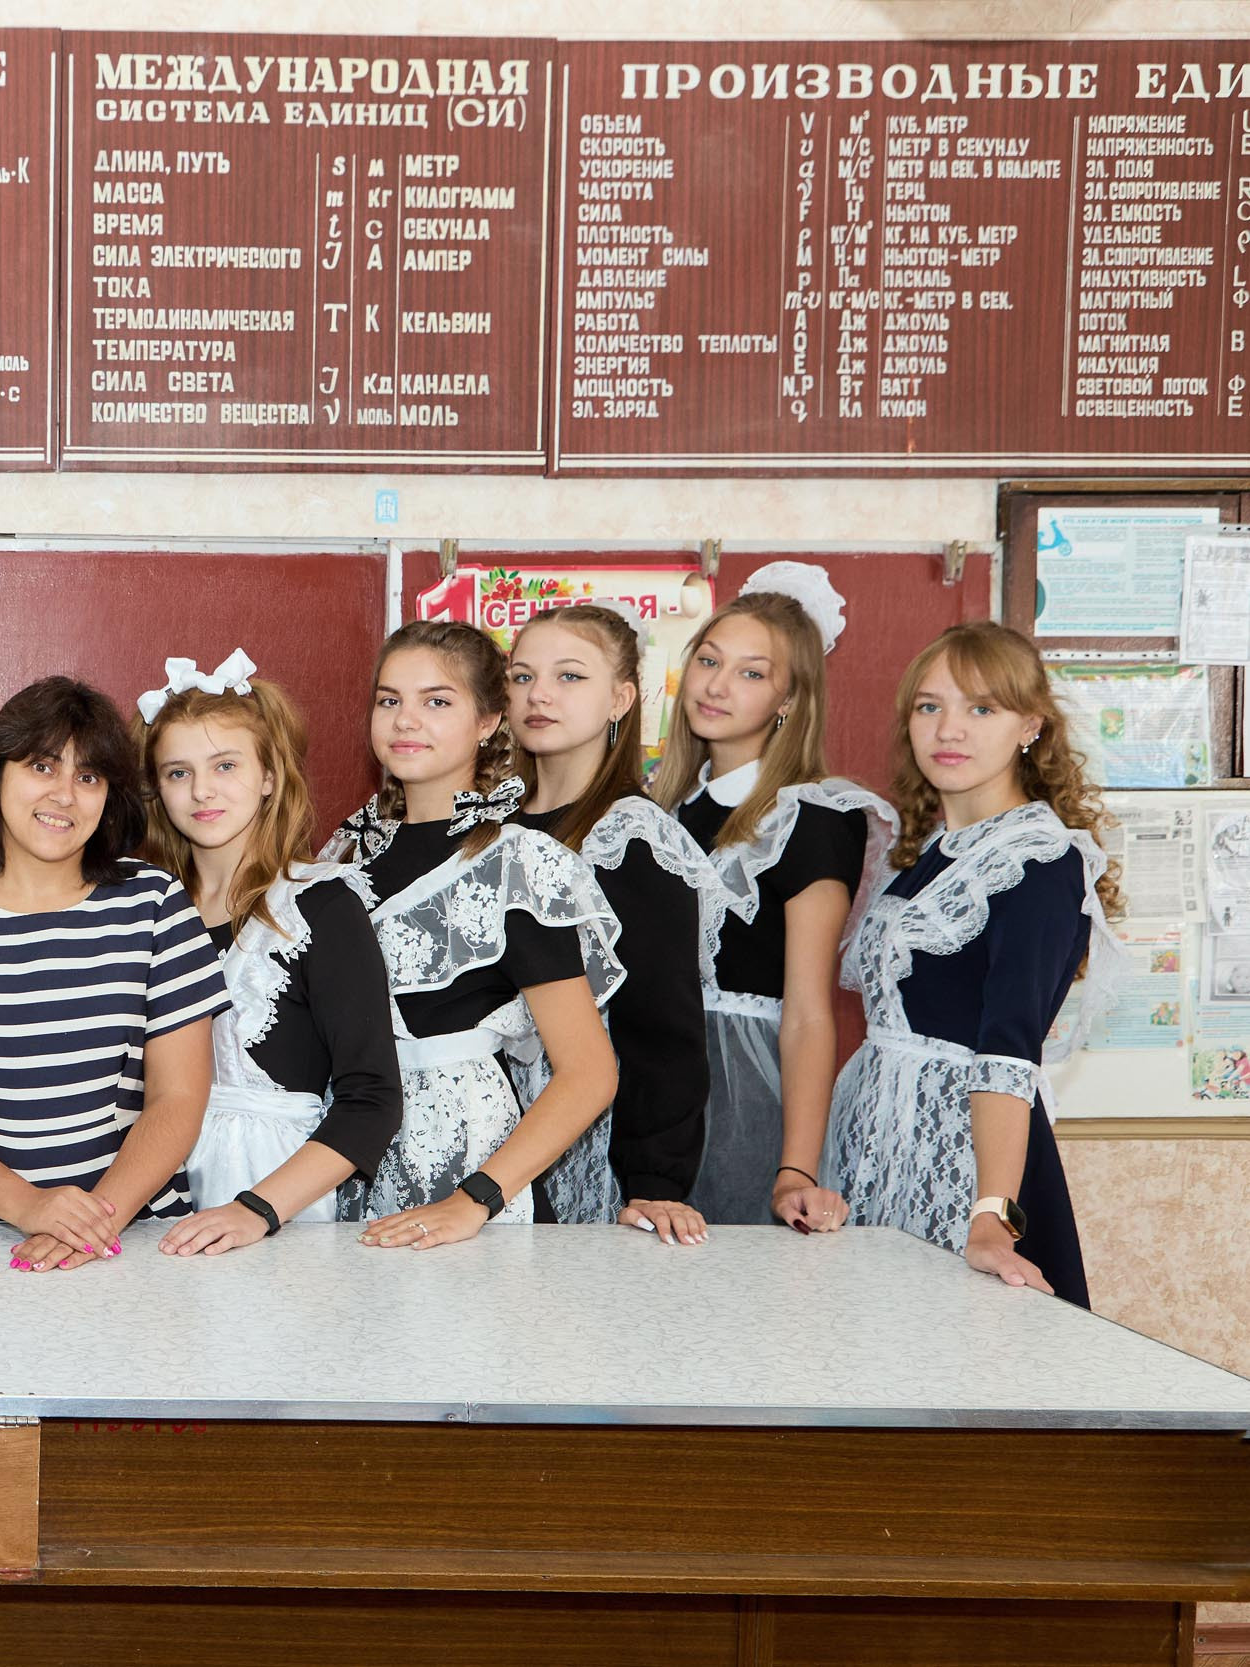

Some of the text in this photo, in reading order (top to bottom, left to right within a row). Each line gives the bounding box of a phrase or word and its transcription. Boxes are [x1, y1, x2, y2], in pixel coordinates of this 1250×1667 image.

[95, 53, 530, 99] МЕЖДУНАРОДНАЯ
[621, 63, 1098, 105] ПРОИЗВОДНЫЕ
[95, 95, 527, 132] СИСТЕМА ЕДИНИЦ (СИ)
[800, 111, 815, 135] V
[1088, 114, 1187, 134] НАПРЯЖЕНИЕ
[580, 114, 642, 135] ОБЪЕМ
[889, 115, 969, 135] КУБ. МЕТР
[579, 137, 666, 157] СКОРОСТЬ
[888, 137, 1030, 157] МЕТР В СЕКУНДУ
[1086, 137, 1214, 157] НАПРЯЖЕННОСТЬ
[93, 149, 231, 175] ДЛИНА, ПУТЬ
[405, 154, 460, 178] МЕТР
[579, 158, 674, 179] УСКОРЕНИЕ
[886, 159, 1061, 179] МЕТР НА СЕК. В КВАДРАТЕ
[1085, 159, 1154, 179] ЭЛ. ПОЛЯ
[93, 181, 165, 205] МАССА
[404, 185, 516, 210] КИЛОГРАММ
[578, 181, 654, 201] ЧАСТОТА
[886, 181, 926, 202] ГЕРЦ
[578, 203, 623, 223] СИЛА
[885, 203, 951, 223] НЬЮТОН
[1083, 203, 1182, 223] ЭЛ. ЕМКОСТЬ
[93, 212, 164, 236] ВРЕМЯ
[403, 217, 491, 241] СЕКУНДА
[577, 224, 674, 245] ПЛОТНОСТЬ
[885, 225, 1018, 245] КГ. НА КУБ. МЕТР
[1082, 225, 1162, 245] УДЕЛЬНОЕ
[92, 244, 302, 269] СИЛА ЭЛЕКТРИЧЕСКОГО
[403, 249, 472, 272] АМПЕР
[576, 246, 709, 267] МОМЕНТ СИЛЫ
[92, 276, 151, 299] ТОКА
[576, 268, 667, 288] ДАВЛЕНИЕ
[884, 269, 952, 288] ПАСКАЛЬ
[1080, 269, 1207, 289] ИНДУКТИВНОСТЬ
[575, 290, 655, 310] ИМПУЛЬС
[961, 291, 973, 310] В
[979, 290, 1014, 310] СЕК.
[1079, 286, 1174, 310] МАГНИТНЫЙ
[92, 307, 295, 332] ТЕРМОДИНАМИЧЕСКАЯ
[401, 311, 491, 335] КЕЛЬВИН
[574, 312, 640, 332] РАБОТА
[883, 312, 950, 331] ДЖОУЛЬ
[1078, 312, 1127, 332] ПОТОК
[92, 339, 236, 362] ТЕМПЕРАТУРА
[574, 334, 778, 354] КОЛИЧЕСТВО ТЕПЛОТЫ
[882, 334, 948, 353] ДЖОУЛЬ
[1077, 334, 1170, 353] МАГНИТНАЯ
[573, 355, 650, 376] ЭНЕРГИЯ
[882, 356, 947, 375] ДЖОУЛЬ
[1077, 356, 1159, 378] ИНДУКЦИЯ
[91, 370, 235, 393] СИЛА СВЕТА
[400, 373, 490, 396] КАНДЕЛА
[573, 378, 674, 400] МОЩНОСТЬ
[880, 377, 922, 397] ВАТТ
[1076, 374, 1209, 396] СВЕТОВОЙ ПОТОК
[91, 401, 310, 427] КОЛИЧЕСТВО ВЕЩЕСТВА
[399, 404, 459, 427] МОЛЬ
[572, 399, 660, 419] ЭЛ. ЗАРЯД
[880, 399, 927, 418] КУЛОН
[1075, 398, 1194, 419] ОСВЕЩЕННОСТЬ
